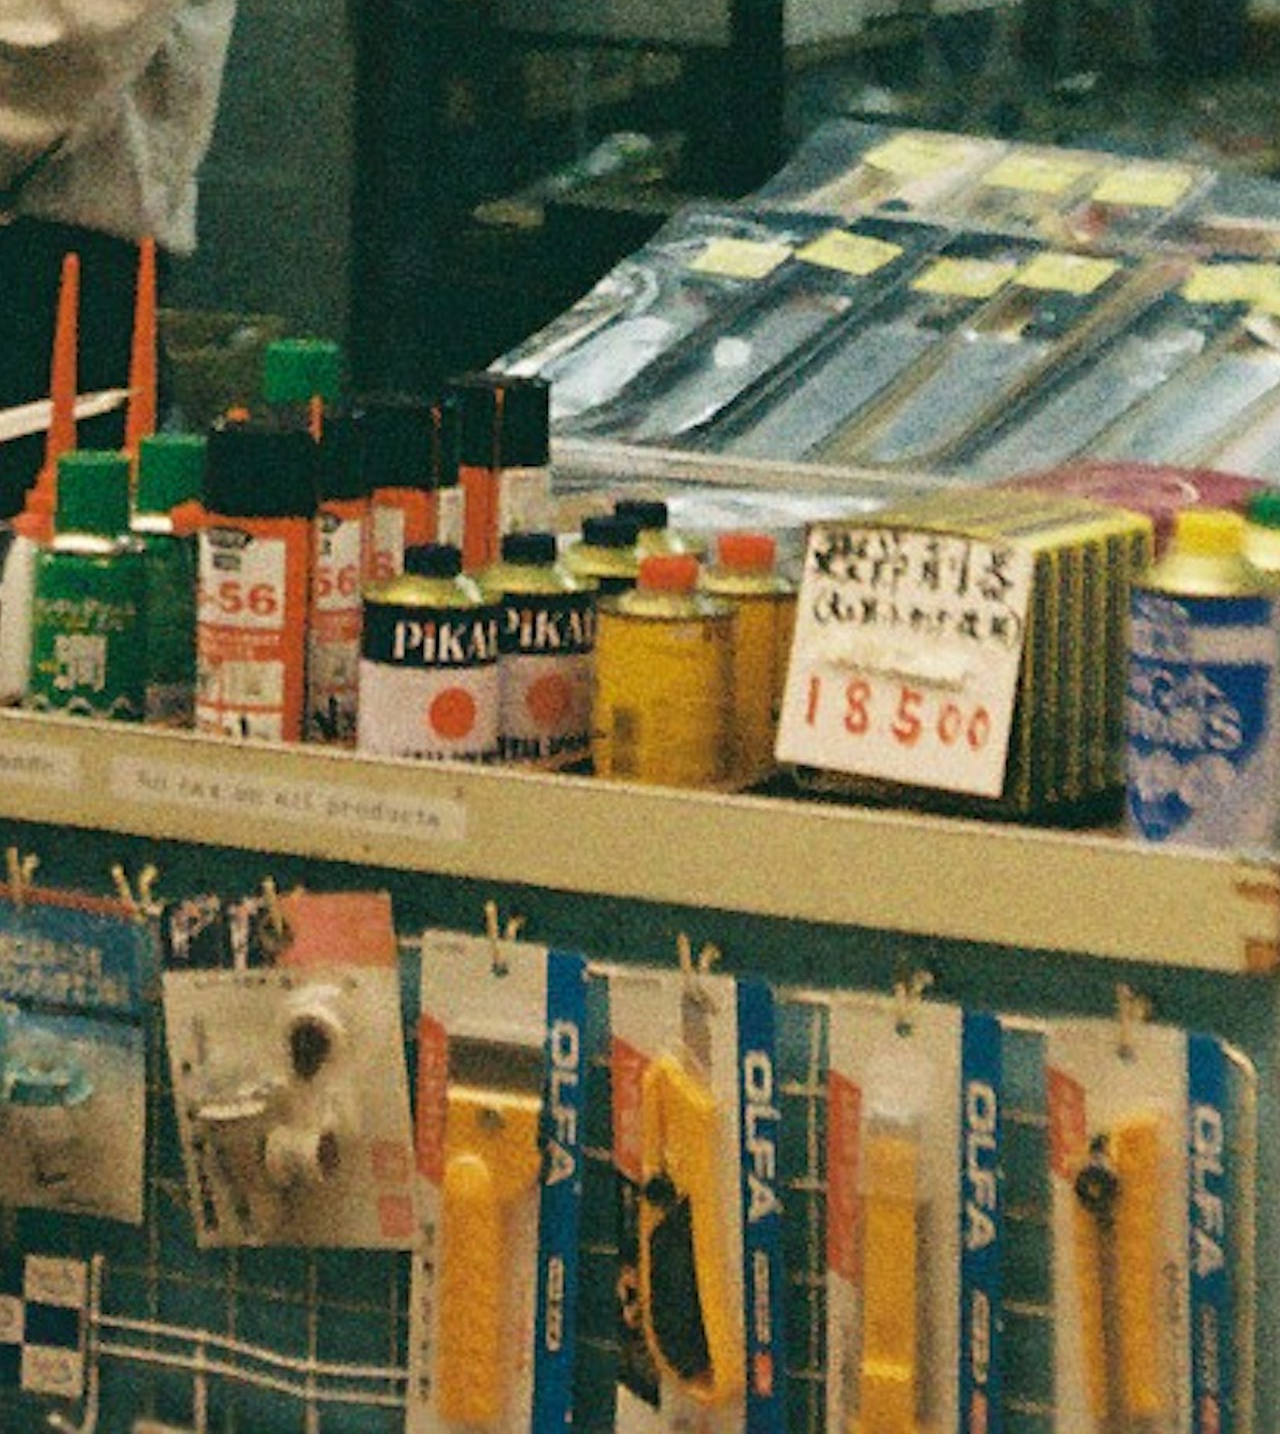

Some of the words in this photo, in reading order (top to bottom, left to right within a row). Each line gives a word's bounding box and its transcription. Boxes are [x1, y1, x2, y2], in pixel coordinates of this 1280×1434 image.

[546, 1019, 580, 1186] OLFA
[743, 1049, 784, 1224] OLFA
[967, 1079, 998, 1250] OLFA
[1193, 1103, 1225, 1278] OLFA
